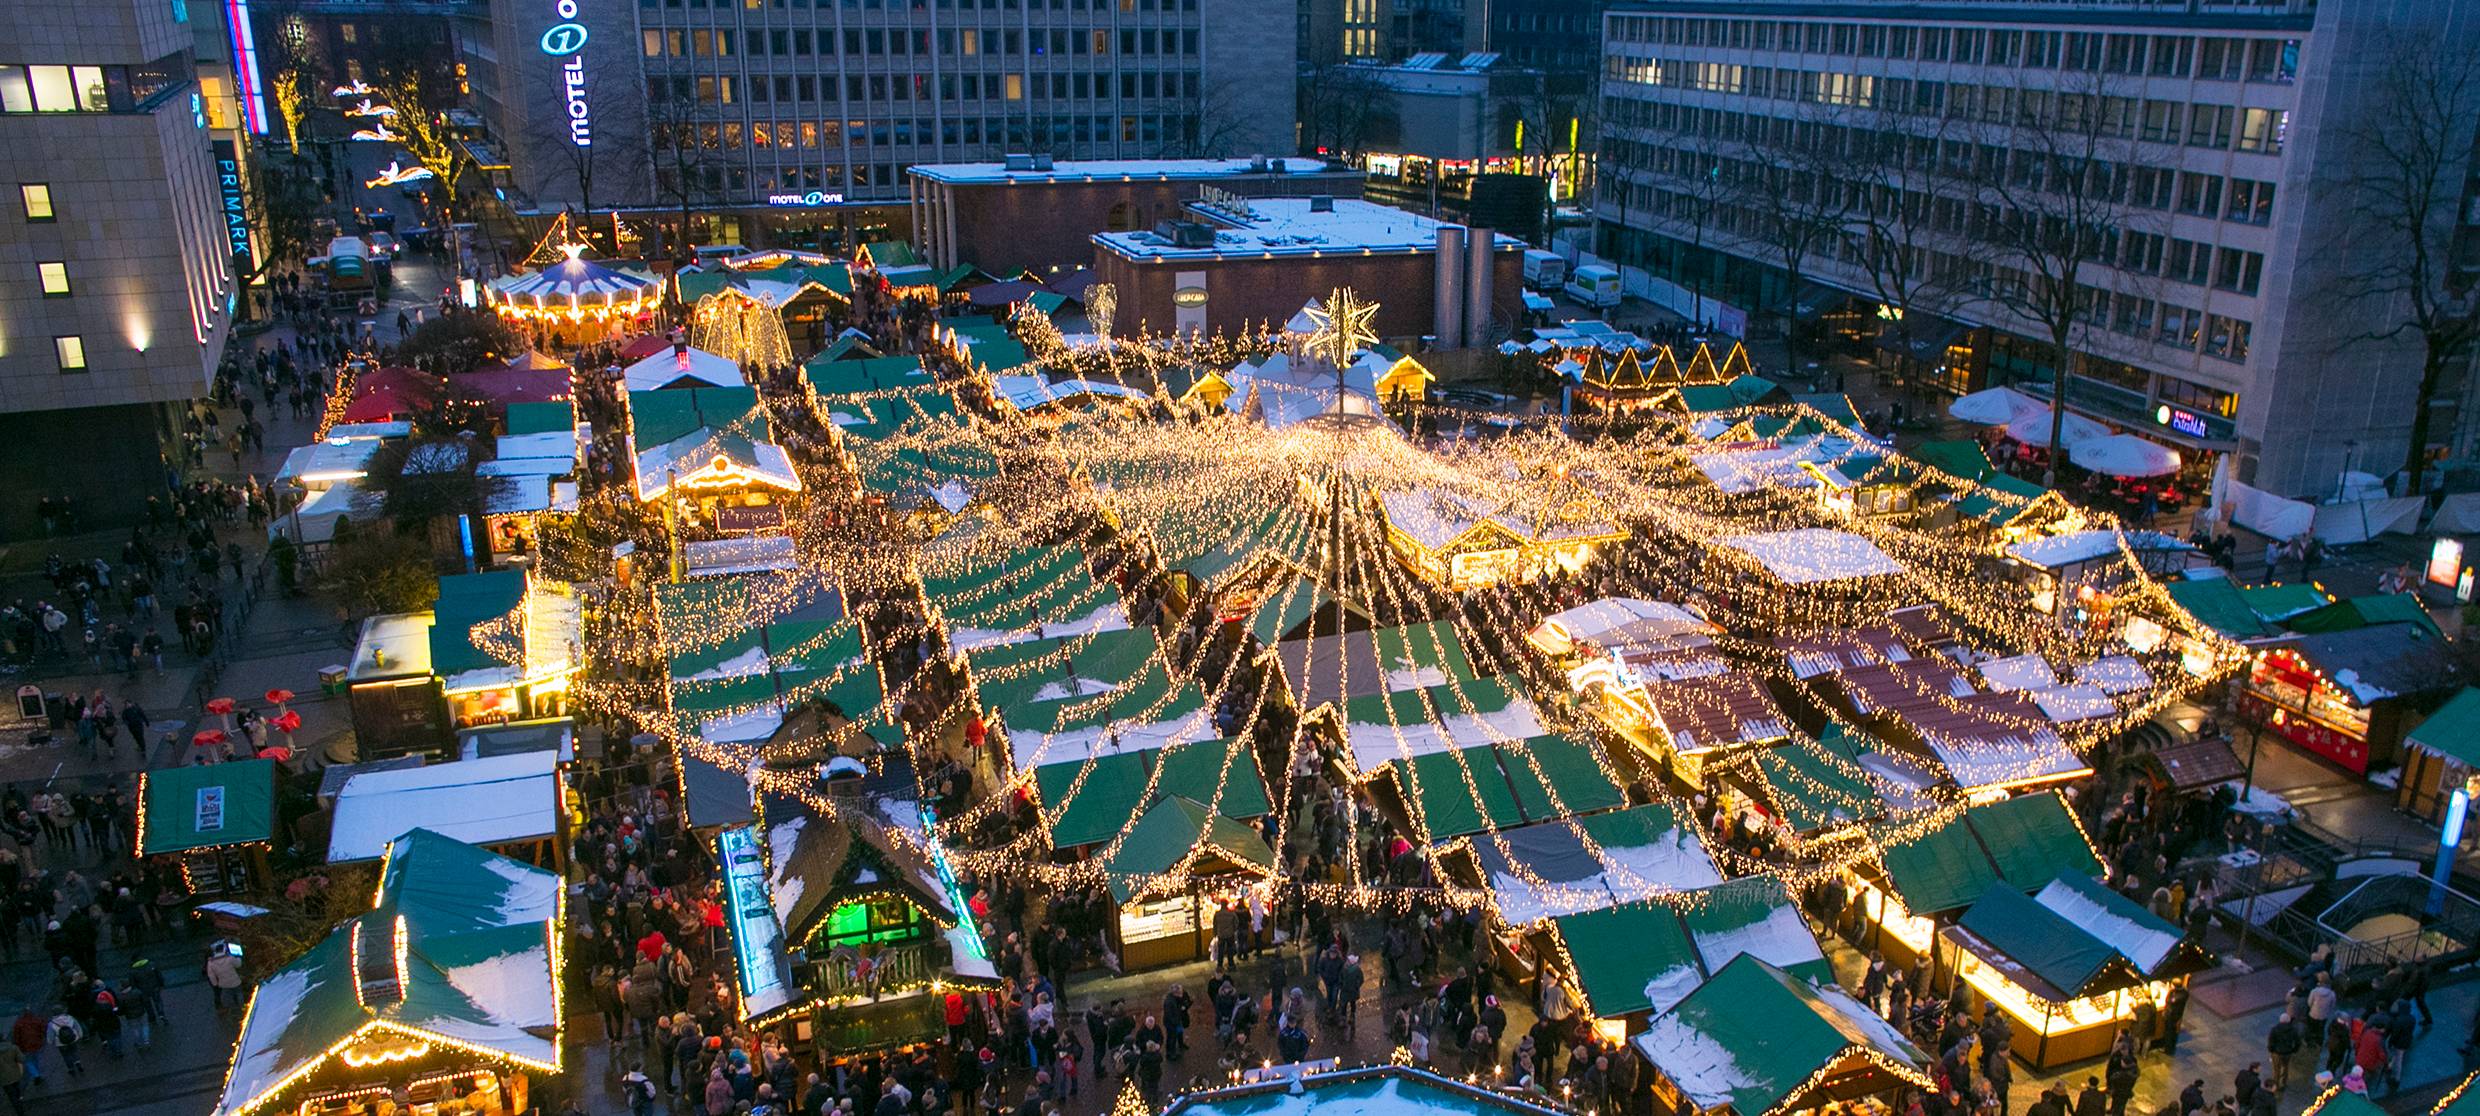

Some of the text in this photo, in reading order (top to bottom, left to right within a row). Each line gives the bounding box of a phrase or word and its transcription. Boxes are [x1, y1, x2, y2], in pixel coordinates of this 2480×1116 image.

[564, 55, 591, 146] MOTEL
[219, 159, 249, 254] PRIMARK
[769, 195, 805, 204] MOTEL
[823, 194, 843, 203] ONE
